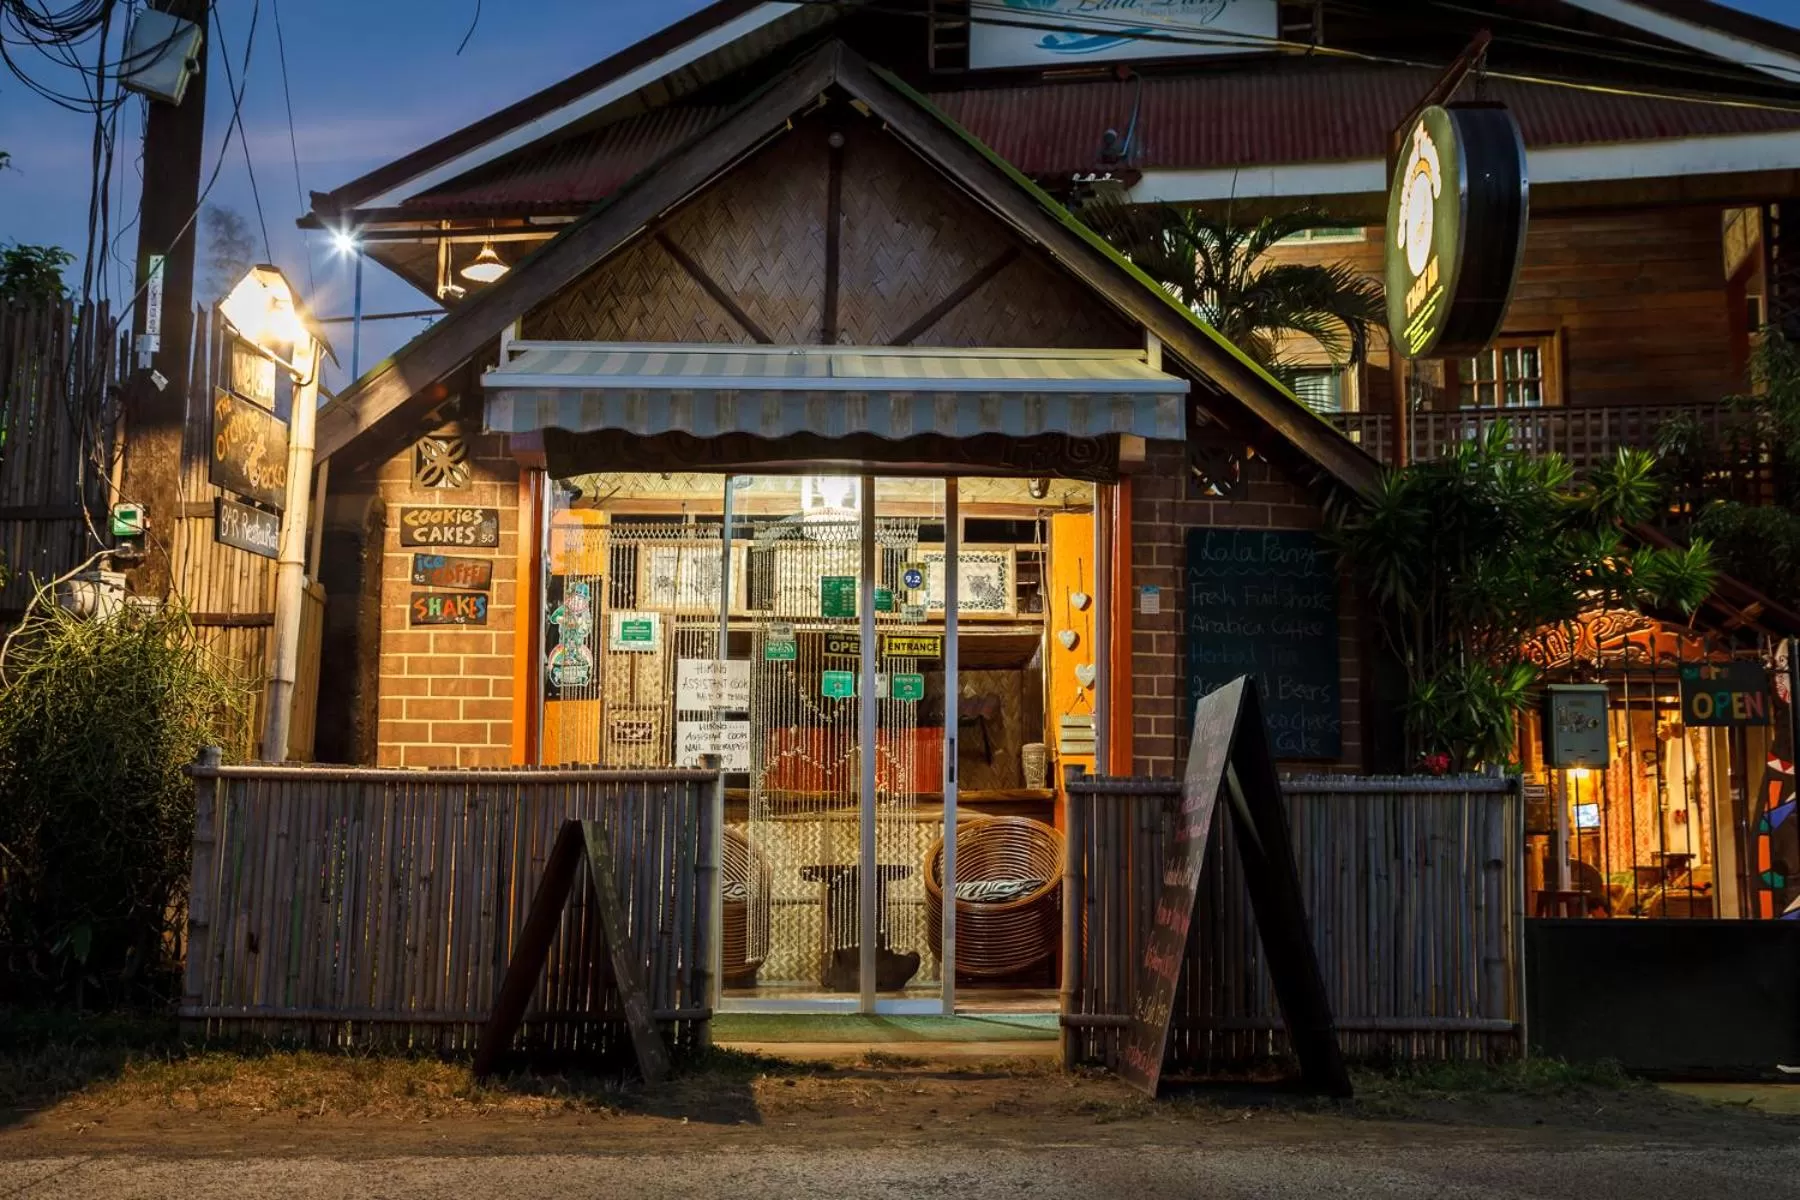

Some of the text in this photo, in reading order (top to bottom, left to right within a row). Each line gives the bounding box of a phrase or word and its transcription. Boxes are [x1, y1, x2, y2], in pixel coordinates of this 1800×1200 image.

[413, 526, 475, 545] CAKES
[413, 595, 486, 621] SHAKES
[829, 641, 860, 653] OPE
[888, 642, 939, 651] ENTRANCE
[1692, 691, 1764, 720] OPEN
